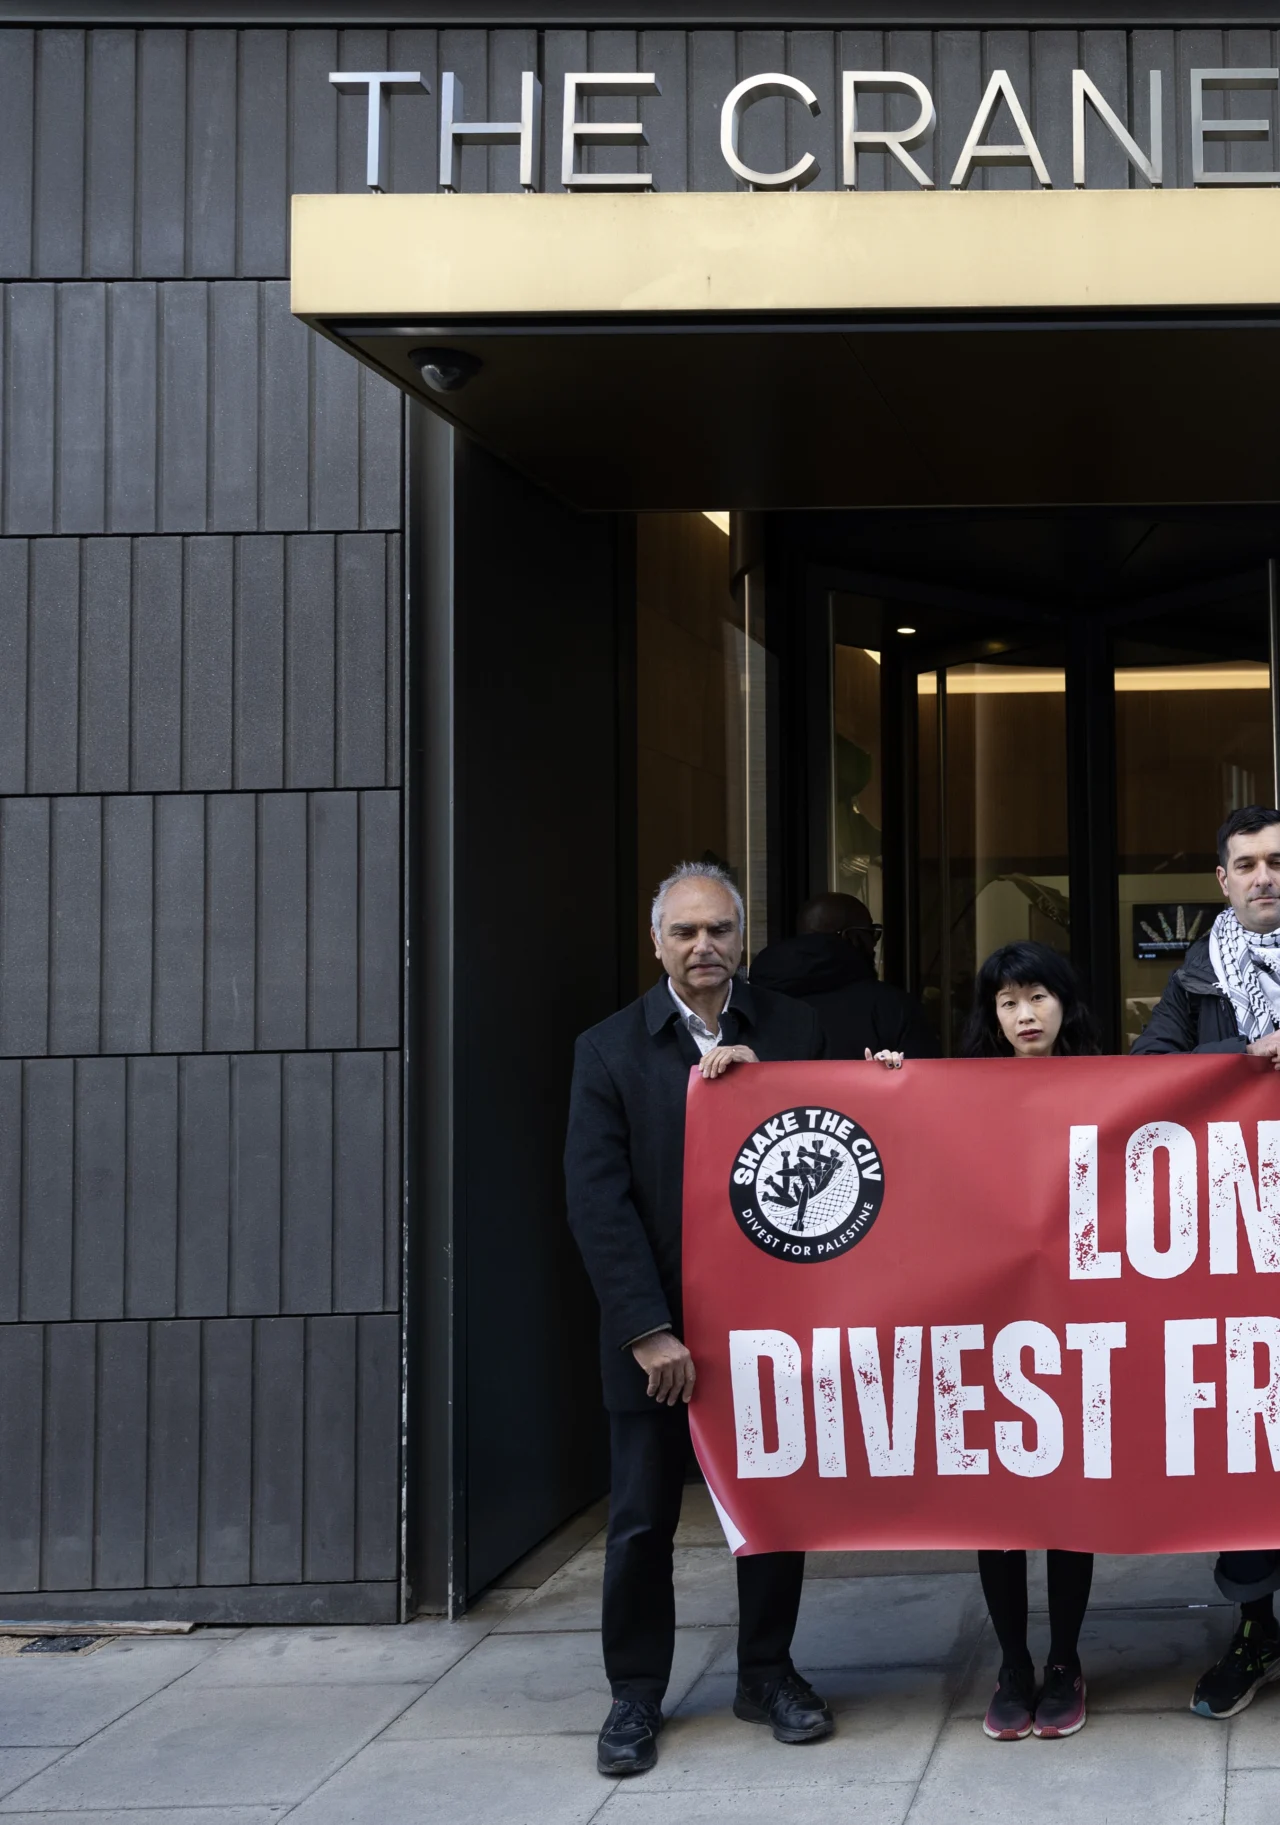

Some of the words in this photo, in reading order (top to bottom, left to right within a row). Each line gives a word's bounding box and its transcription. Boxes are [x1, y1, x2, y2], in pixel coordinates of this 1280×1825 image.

[328, 71, 663, 193] THE
[733, 1112, 799, 1185] SHAKE
[805, 1109, 855, 1140] THE
[851, 1138, 882, 1181] CIV
[741, 1208, 780, 1248] DIVEST
[783, 1243, 811, 1256] FOR
[817, 1201, 874, 1254] PALESTINE
[729, 1320, 1127, 1479] DIVEST
